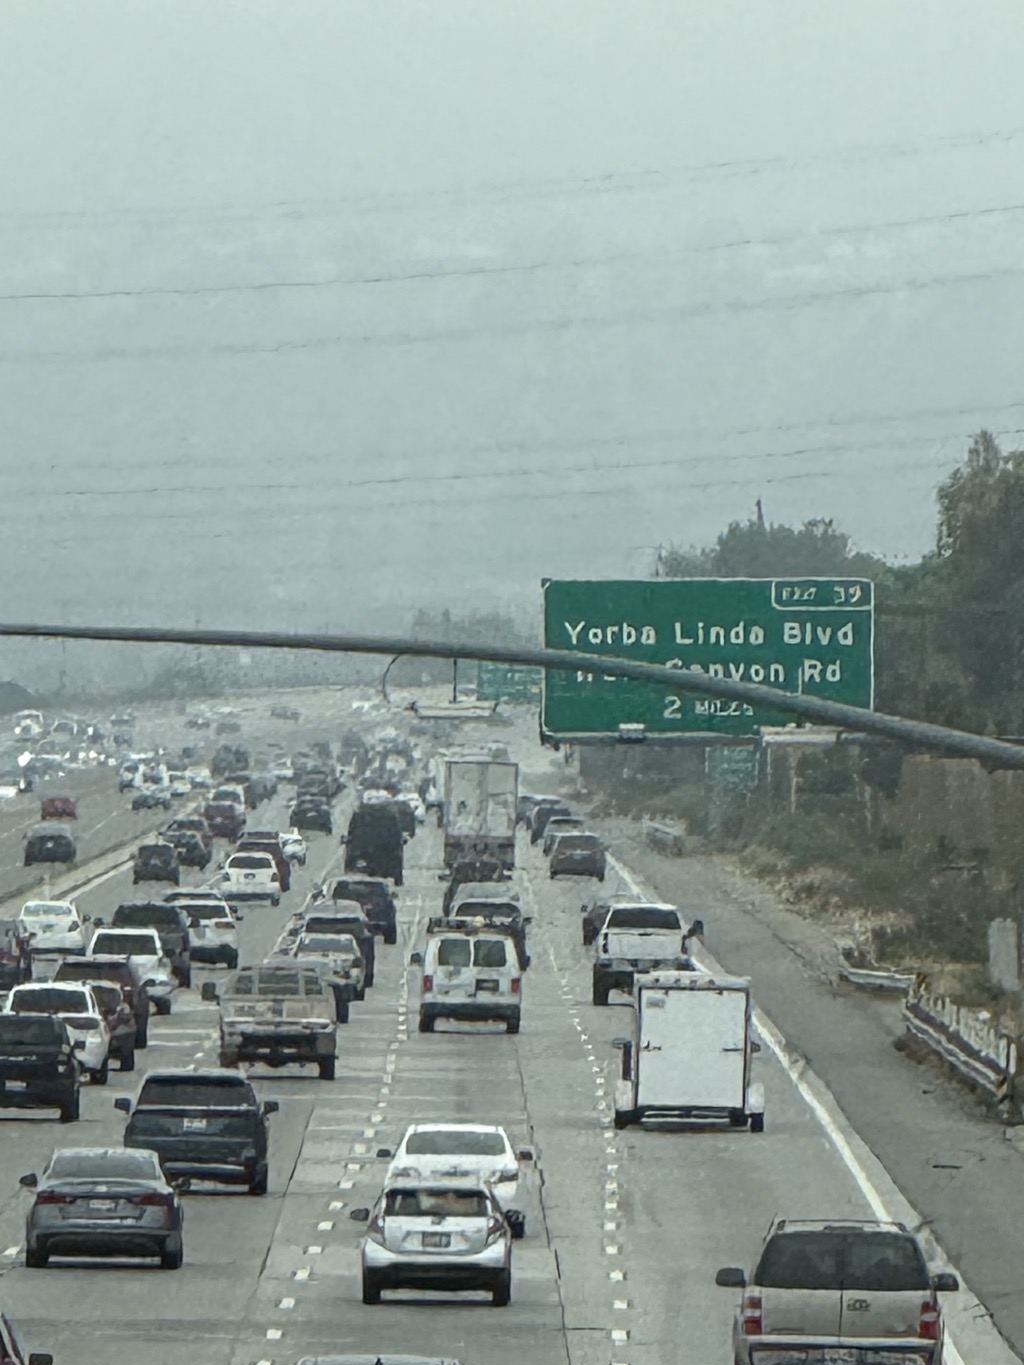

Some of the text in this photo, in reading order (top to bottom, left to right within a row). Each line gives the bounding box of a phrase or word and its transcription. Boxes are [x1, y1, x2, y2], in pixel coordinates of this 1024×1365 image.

[564, 620, 853, 646] Yorba Linda Blvd
[803, 658, 841, 683] Rd
[663, 696, 682, 719] 2
